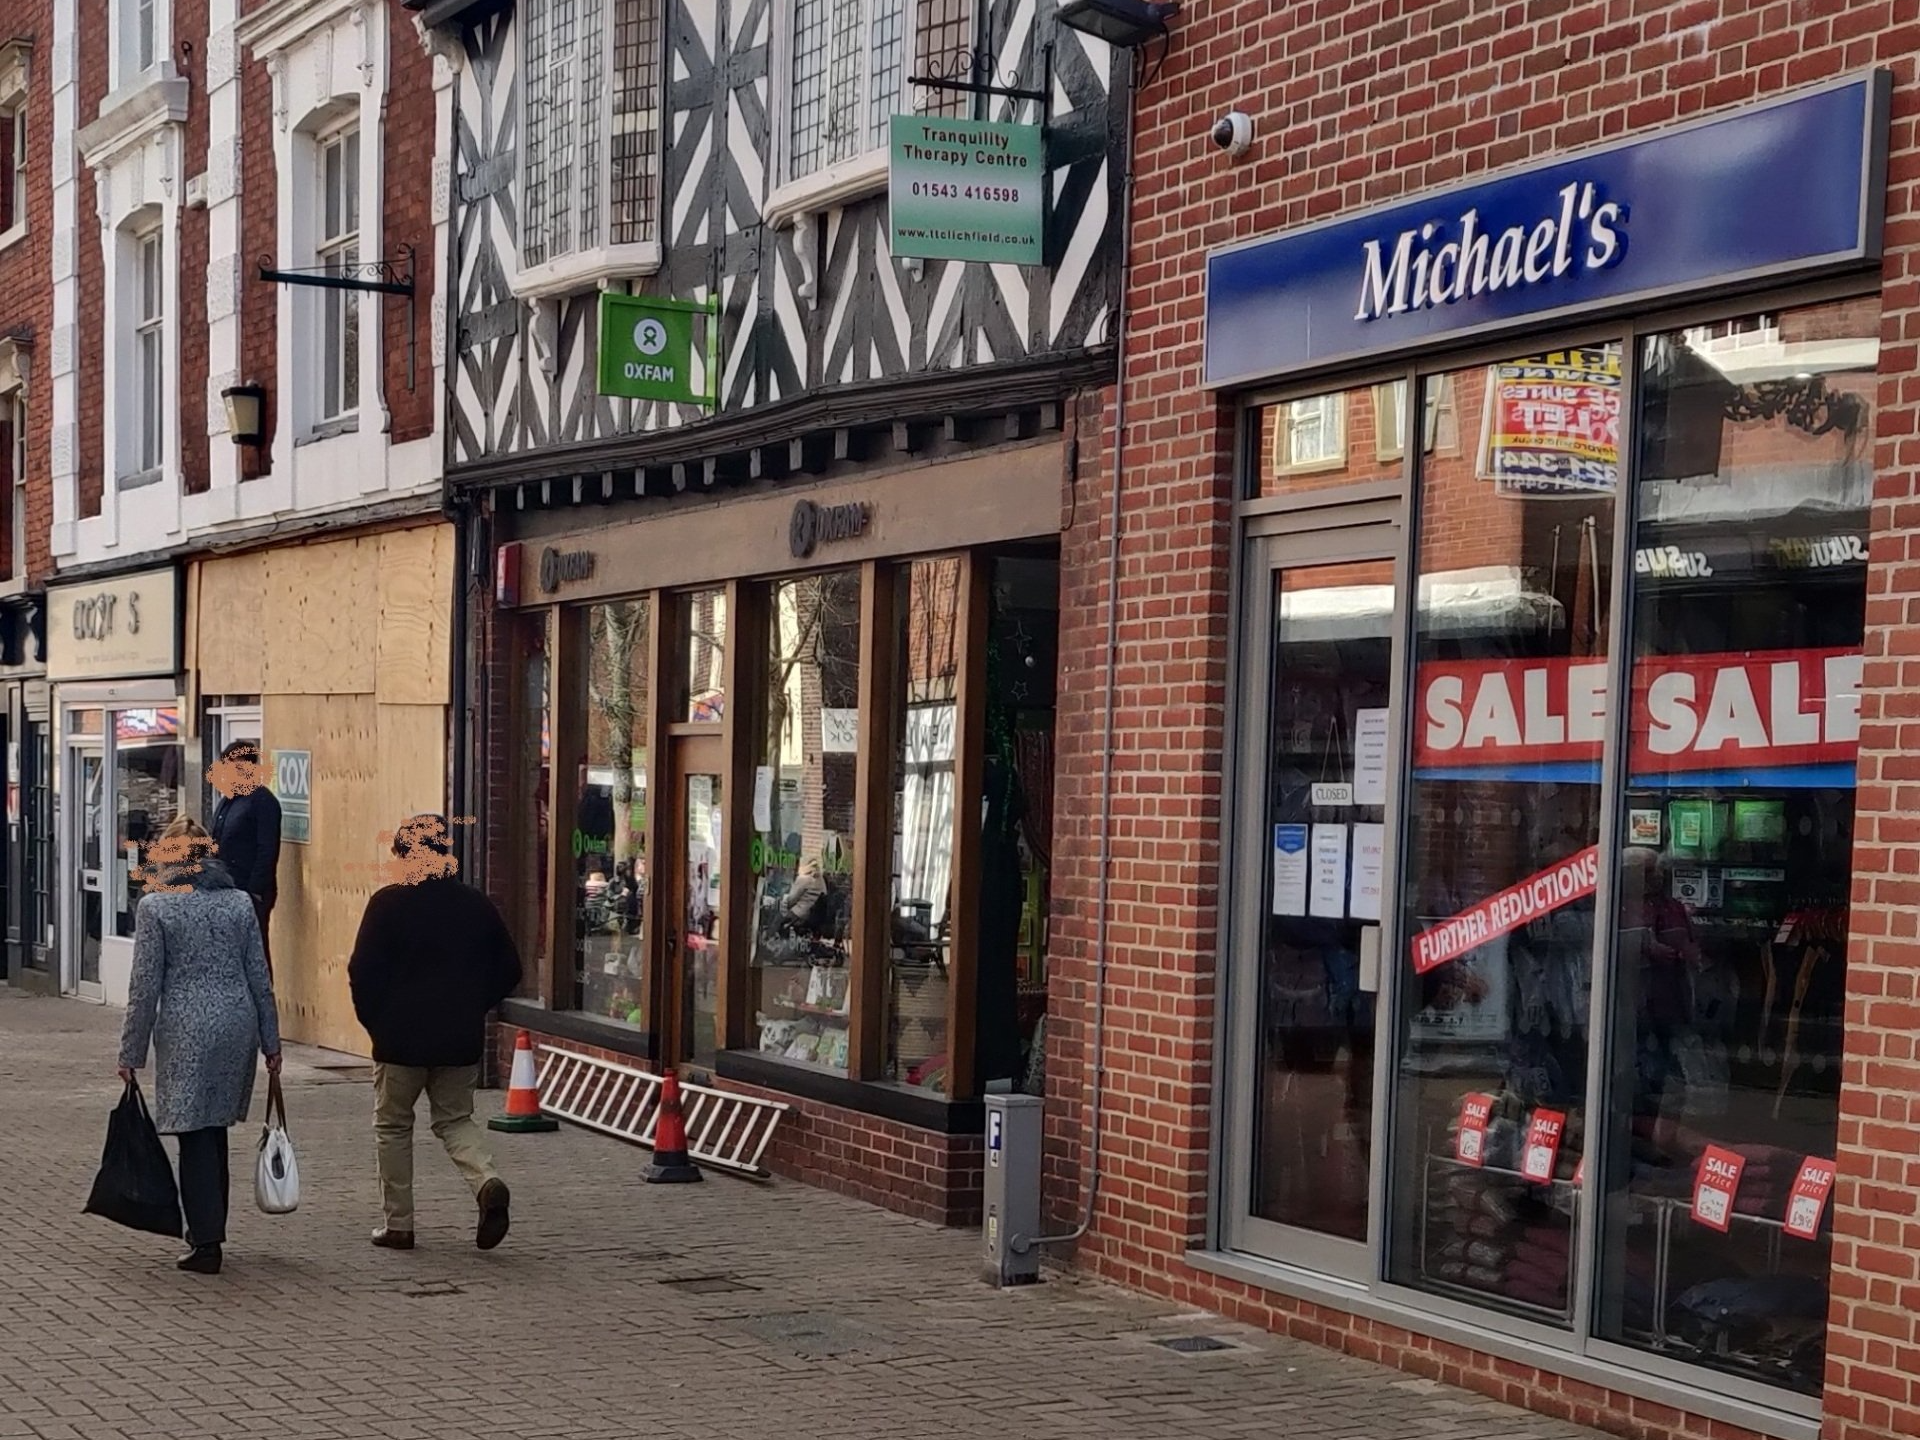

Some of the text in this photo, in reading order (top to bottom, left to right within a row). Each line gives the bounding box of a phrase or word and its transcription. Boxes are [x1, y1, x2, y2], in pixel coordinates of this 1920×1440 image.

[922, 127, 1009, 150] Tranquility
[903, 144, 1028, 168] Therapy Centre
[912, 181, 1019, 203] 01543 416598
[898, 227, 1036, 246] www.ttclichfield.co.uk
[1354, 181, 1619, 320] Michael's
[624, 361, 674, 383] OXFAM
[815, 502, 865, 541] OXFAM
[1426, 654, 1863, 755] SALE SALE
[279, 757, 309, 795] COX
[1315, 787, 1348, 801] CLOSED
[766, 847, 797, 870] Oxfam
[1418, 853, 1599, 968] FURTHER REDUCTIONS
[1464, 1102, 1487, 1119] SALE
[1533, 1118, 1560, 1135] SALE
[1705, 1156, 1738, 1179] SALE
[1801, 1167, 1832, 1186] SALE
[1703, 1172, 1733, 1189] price
[1798, 1182, 1824, 1196] price
